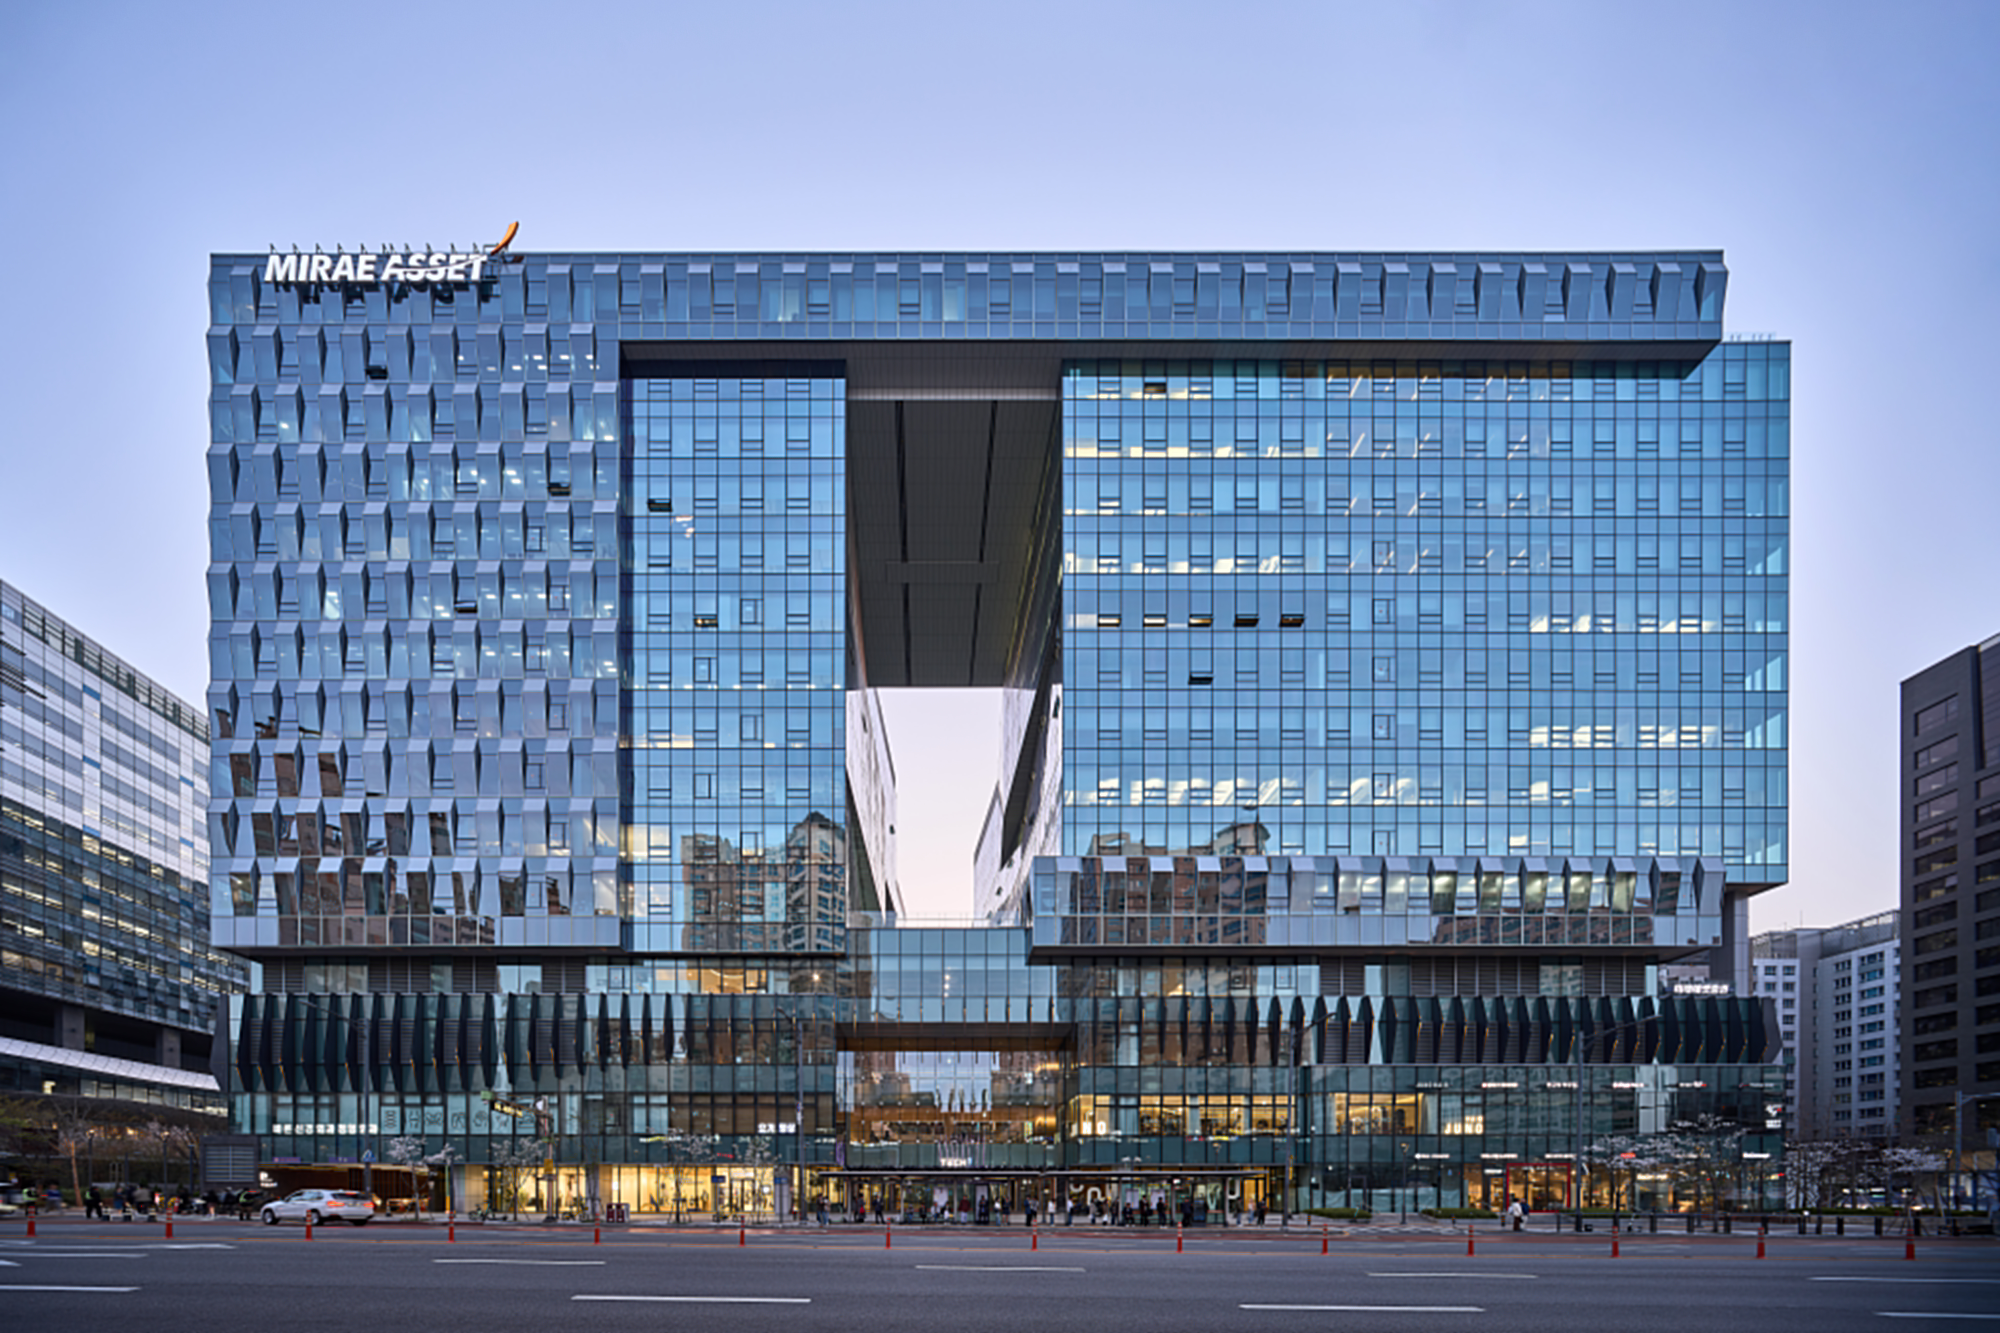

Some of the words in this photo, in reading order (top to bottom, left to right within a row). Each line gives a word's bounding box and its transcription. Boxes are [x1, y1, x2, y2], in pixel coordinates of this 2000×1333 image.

[264, 254, 377, 282] MIRAE
[380, 252, 488, 282] ASSET
[1444, 1122, 1484, 1135] JUNO
